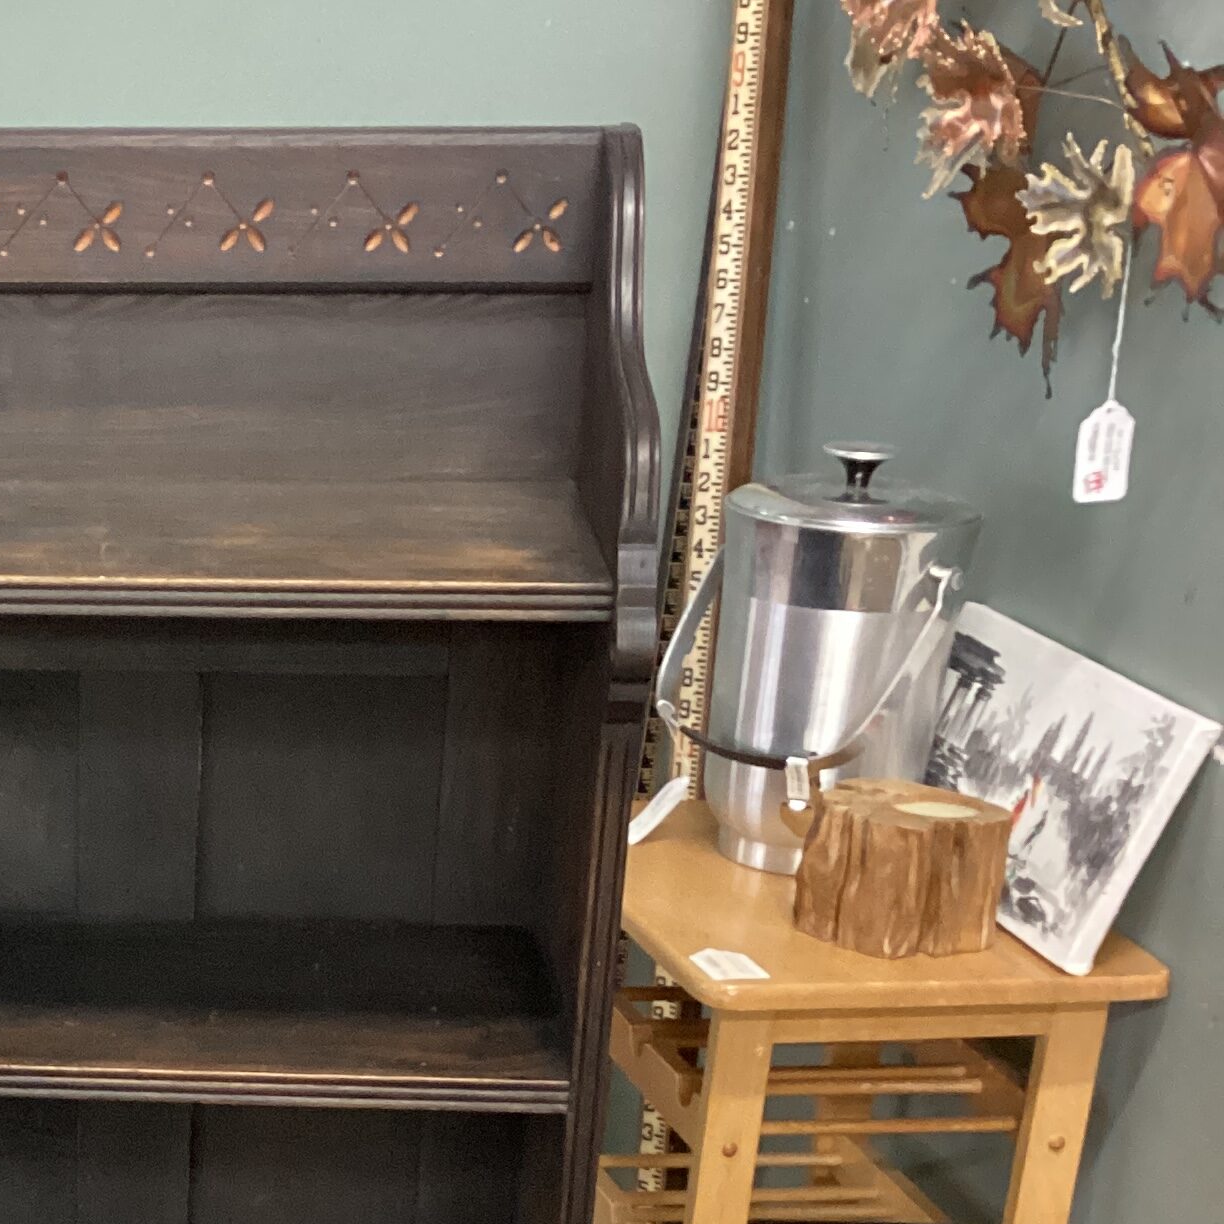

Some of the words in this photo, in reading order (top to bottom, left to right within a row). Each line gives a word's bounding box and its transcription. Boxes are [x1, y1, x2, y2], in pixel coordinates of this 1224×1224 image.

[737, 22, 749, 44] 9
[732, 50, 746, 87] 9
[731, 94, 739, 115] 1
[727, 128, 740, 150] 2
[724, 164, 737, 186] 3
[722, 199, 734, 221] 4
[719, 234, 731, 255] 5
[715, 268, 729, 290] 6
[714, 303, 726, 324] 7
[709, 337, 722, 358] 8
[707, 371, 719, 392] 9
[702, 438, 711, 459] 1
[698, 472, 711, 492] 2
[694, 506, 708, 525] 3
[692, 540, 705, 559] 4
[682, 667, 694, 687] 8
[679, 699, 691, 718] 9
[642, 1123, 653, 1141] 3
